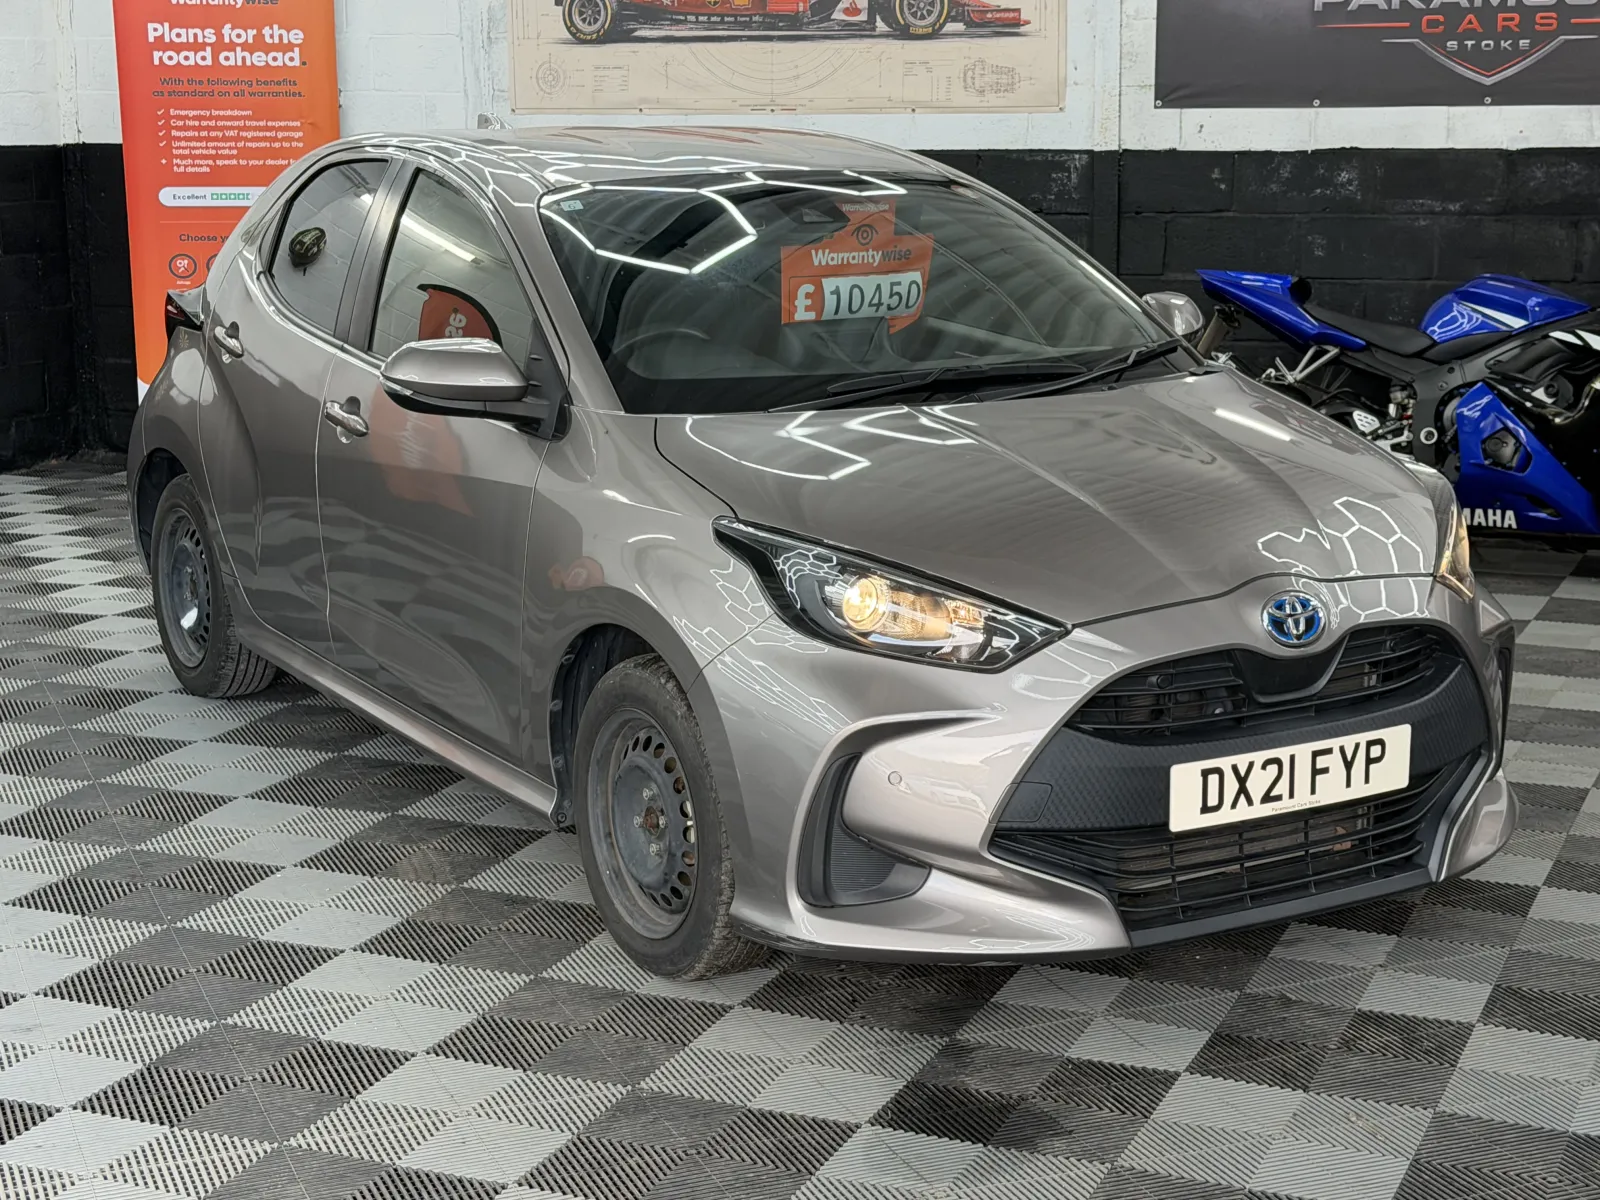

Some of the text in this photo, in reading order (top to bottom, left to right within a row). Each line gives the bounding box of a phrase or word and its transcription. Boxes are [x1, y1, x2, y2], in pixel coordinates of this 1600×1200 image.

[1421, 12, 1558, 34] CARS
[147, 22, 304, 44] Plans for the
[1446, 39, 1532, 51] STOKE
[153, 46, 307, 66] road ahead.
[160, 78, 297, 88] With the following benefits
[168, 89, 214, 97] standard
[233, 89, 245, 97] all
[248, 90, 305, 98] warranties.
[170, 109, 210, 117] Emergency
[240, 130, 276, 138] registered
[215, 158, 238, 167] speak
[179, 234, 218, 242] Choose
[811, 244, 912, 266] Warrantywise
[794, 280, 921, 320] £ 10450
[1200, 737, 1387, 815] DX21 FYP
